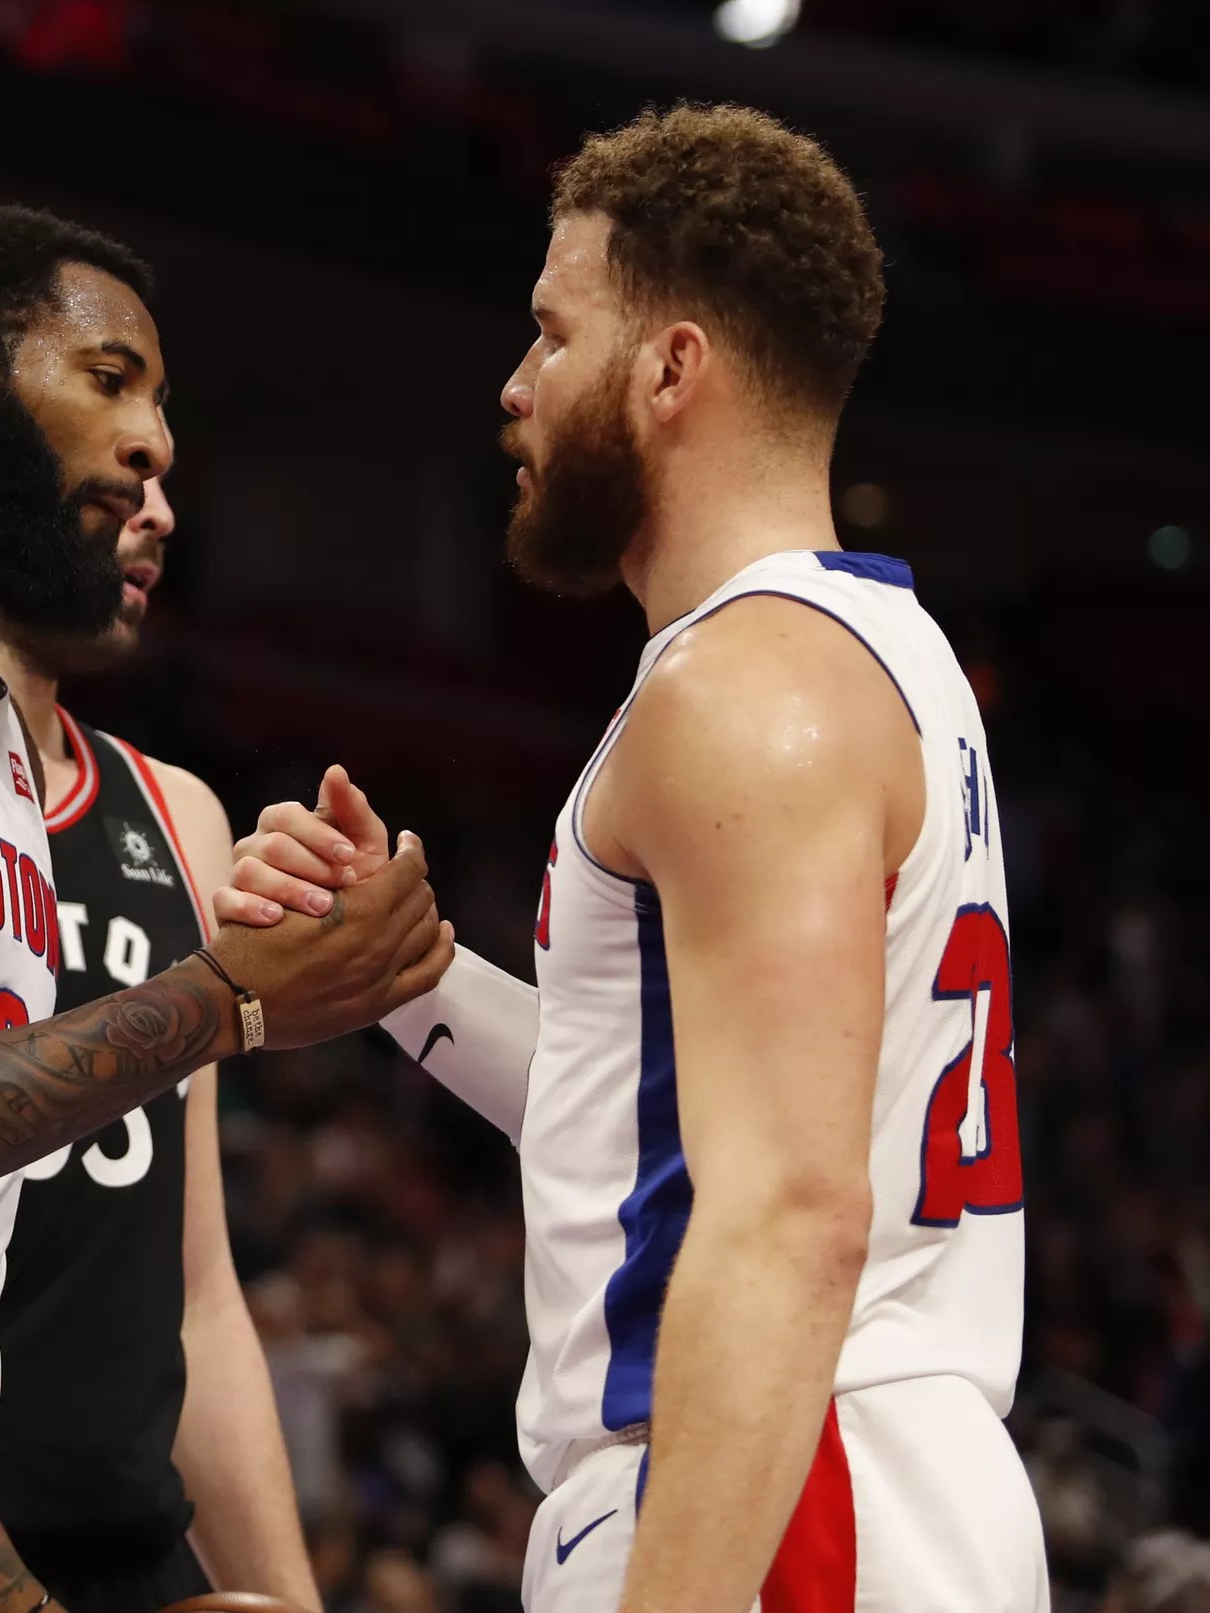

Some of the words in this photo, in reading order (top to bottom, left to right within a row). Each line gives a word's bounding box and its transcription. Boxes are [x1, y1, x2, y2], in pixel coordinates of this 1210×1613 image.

[121, 863, 150, 881] Sun
[149, 866, 174, 887] Life
[251, 1008, 260, 1022] be
[253, 1022, 263, 1038] the
